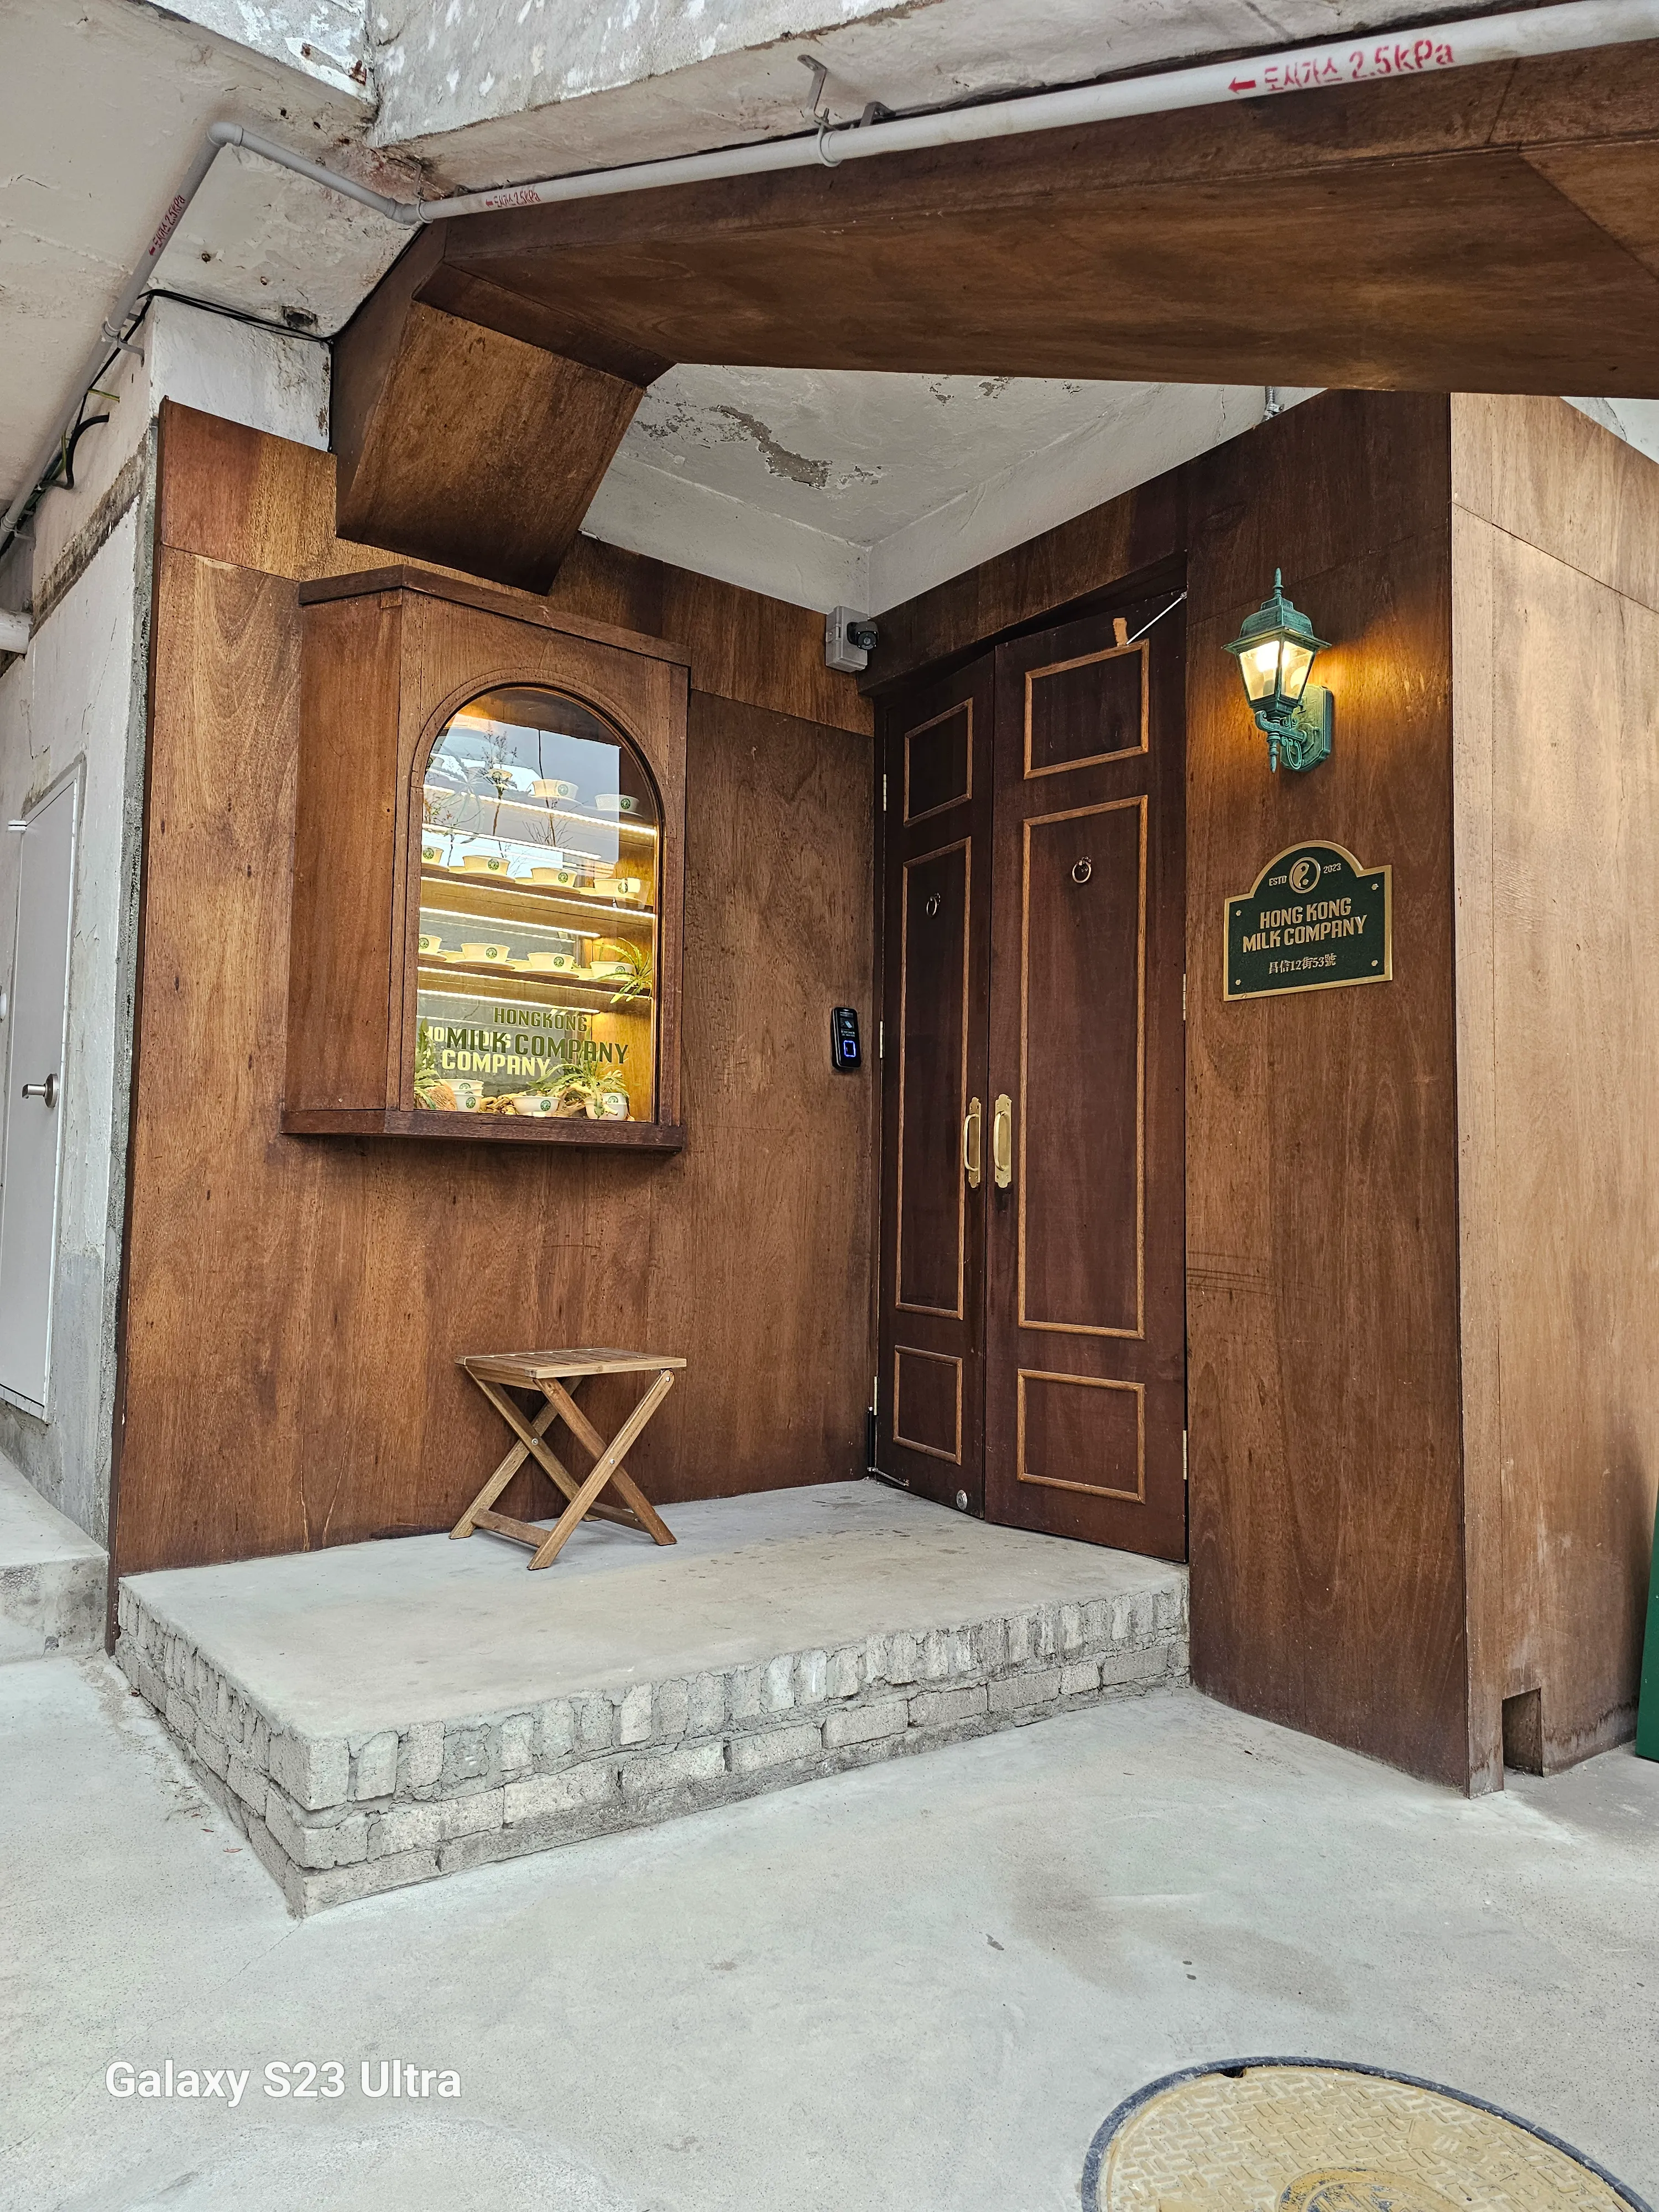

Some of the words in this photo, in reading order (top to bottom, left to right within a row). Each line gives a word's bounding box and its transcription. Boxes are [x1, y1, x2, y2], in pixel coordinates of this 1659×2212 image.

[1264, 58, 1343, 92] 도시가스
[1349, 39, 1454, 81] 2.5kPa
[1269, 875, 1287, 886] ESTD
[1323, 863, 1342, 874] 2023
[1260, 906, 1303, 929] HONG
[1306, 897, 1352, 922] KONG
[1243, 929, 1281, 953] MILK
[1284, 915, 1368, 946] COMPANY
[493, 1007, 588, 1032] HONGKONG
[446, 1026, 507, 1053] MILK
[515, 1033, 629, 1064] COMPANY
[442, 1050, 551, 1077] COMPANY
